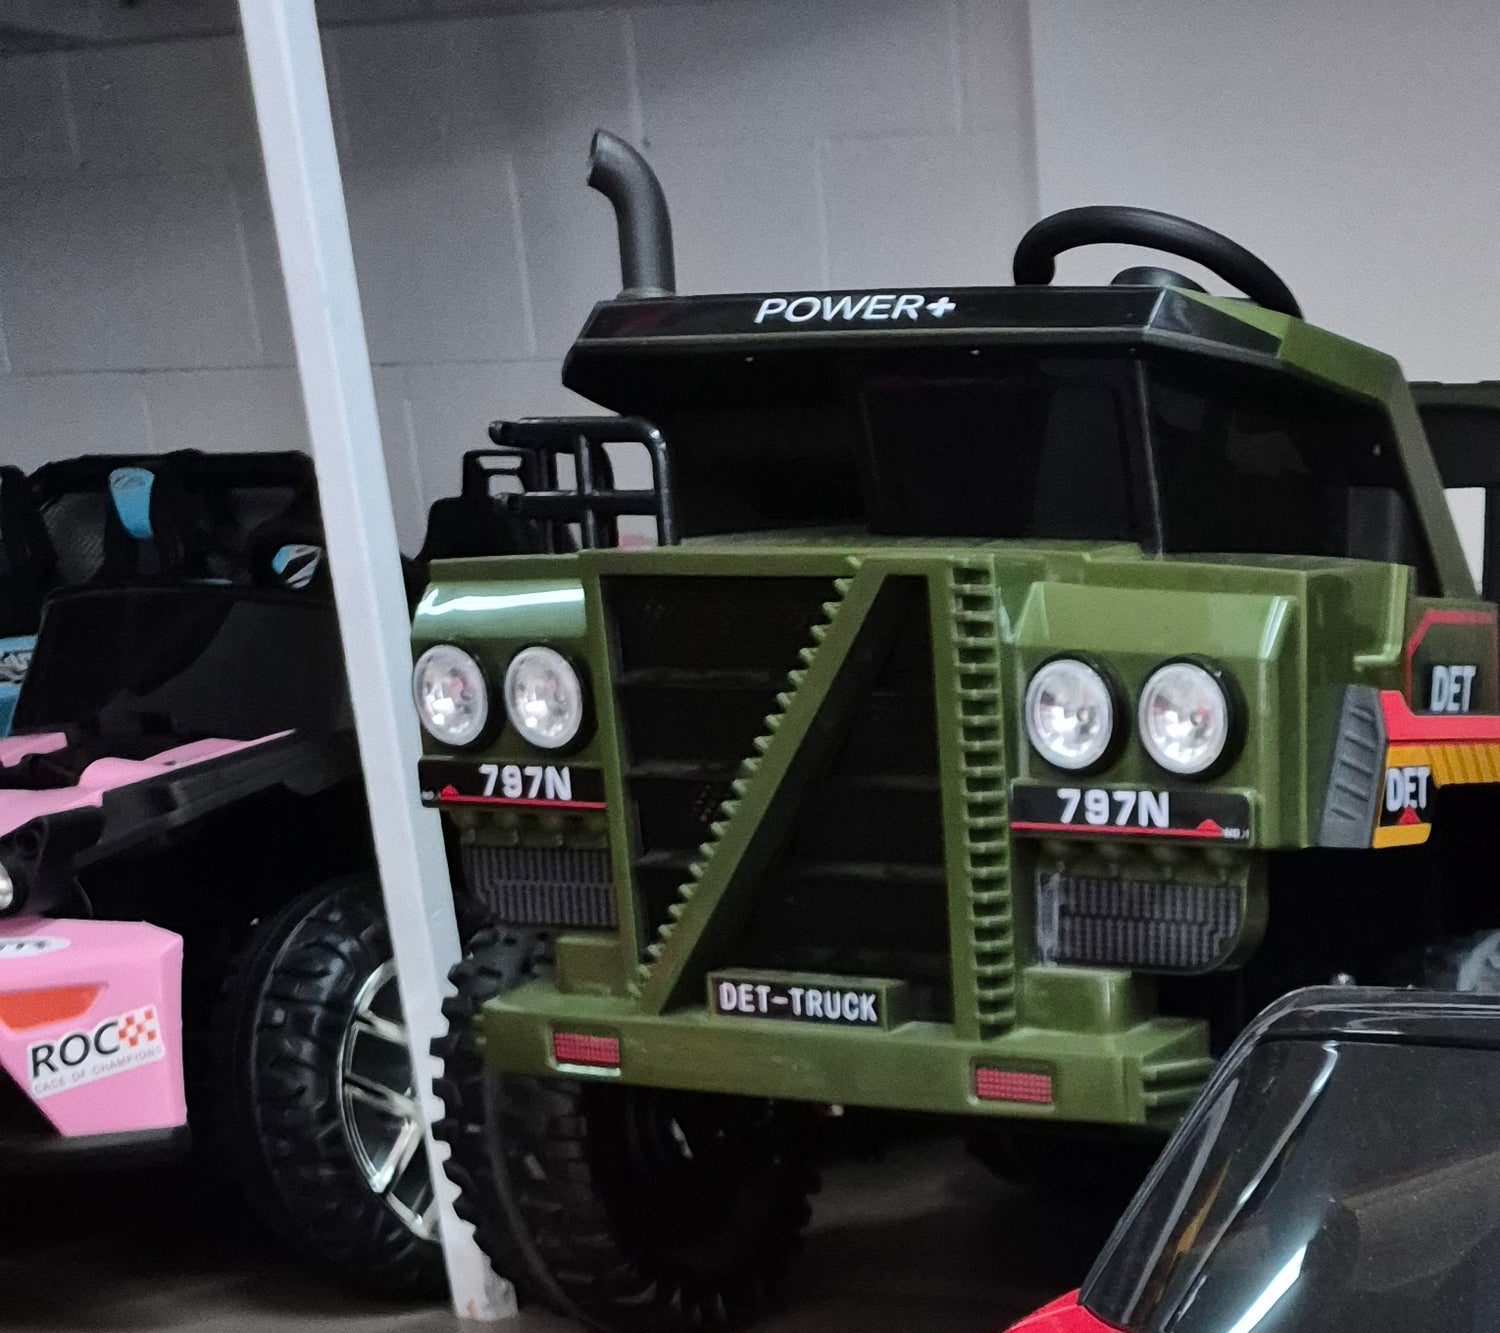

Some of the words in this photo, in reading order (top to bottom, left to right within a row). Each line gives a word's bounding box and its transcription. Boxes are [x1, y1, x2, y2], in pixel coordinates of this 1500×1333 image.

[754, 294, 957, 324] POWER+
[1429, 665, 1477, 713] DET
[478, 763, 573, 800] 797N
[1386, 766, 1431, 812] DET
[1056, 788, 1170, 829] 797N
[718, 982, 878, 1022] DET-TRUCK
[32, 1020, 121, 1078] ROC
